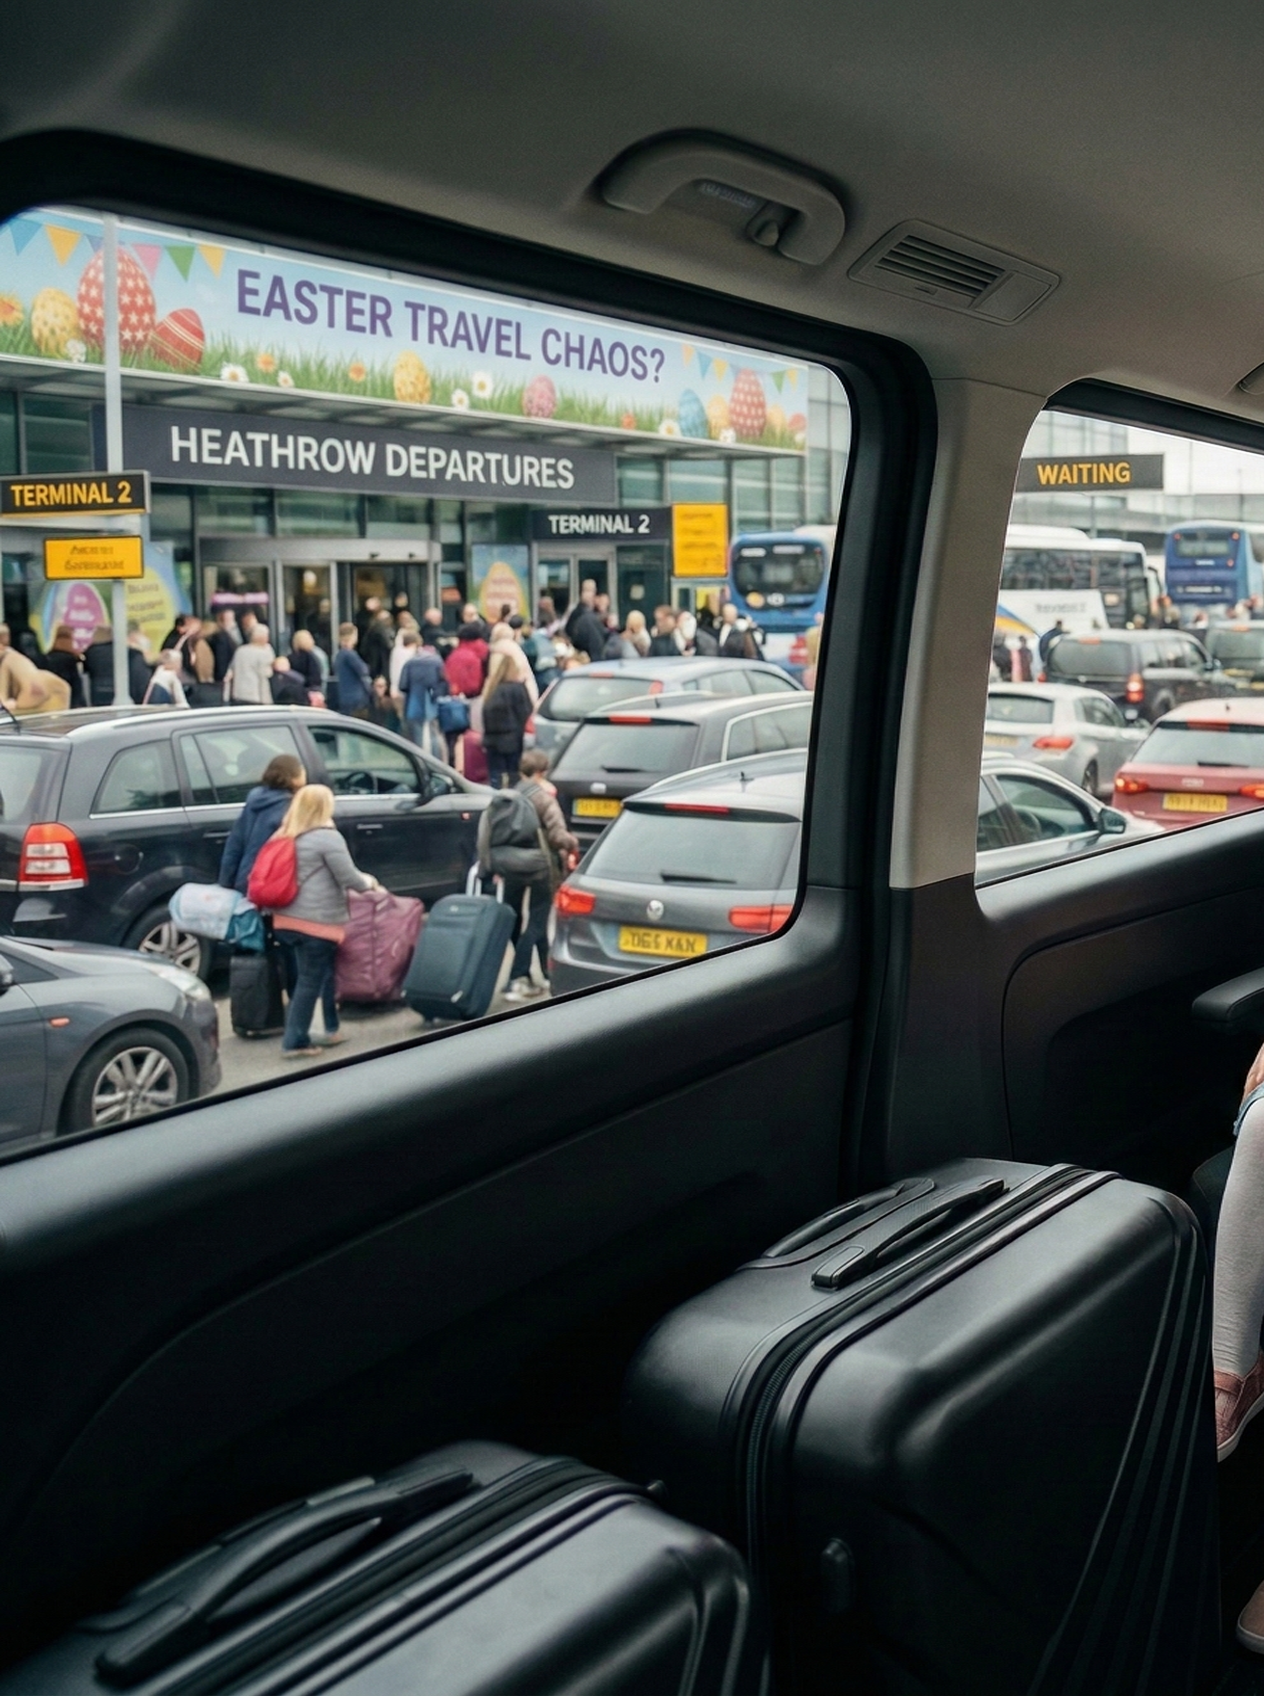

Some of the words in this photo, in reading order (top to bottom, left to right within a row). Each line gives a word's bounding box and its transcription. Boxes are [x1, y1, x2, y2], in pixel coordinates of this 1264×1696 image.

[236, 268, 393, 338] EASTER
[404, 300, 532, 361] TRAVEL
[541, 328, 666, 383] CHAOS?
[170, 425, 375, 475] HEATHROW
[385, 443, 575, 489] DEPARTURES
[1037, 462, 1131, 485] WAITING
[10, 481, 114, 507] TERMINAL
[117, 480, 132, 503] 2
[548, 514, 634, 535] TERMINAL
[637, 514, 650, 534] 2
